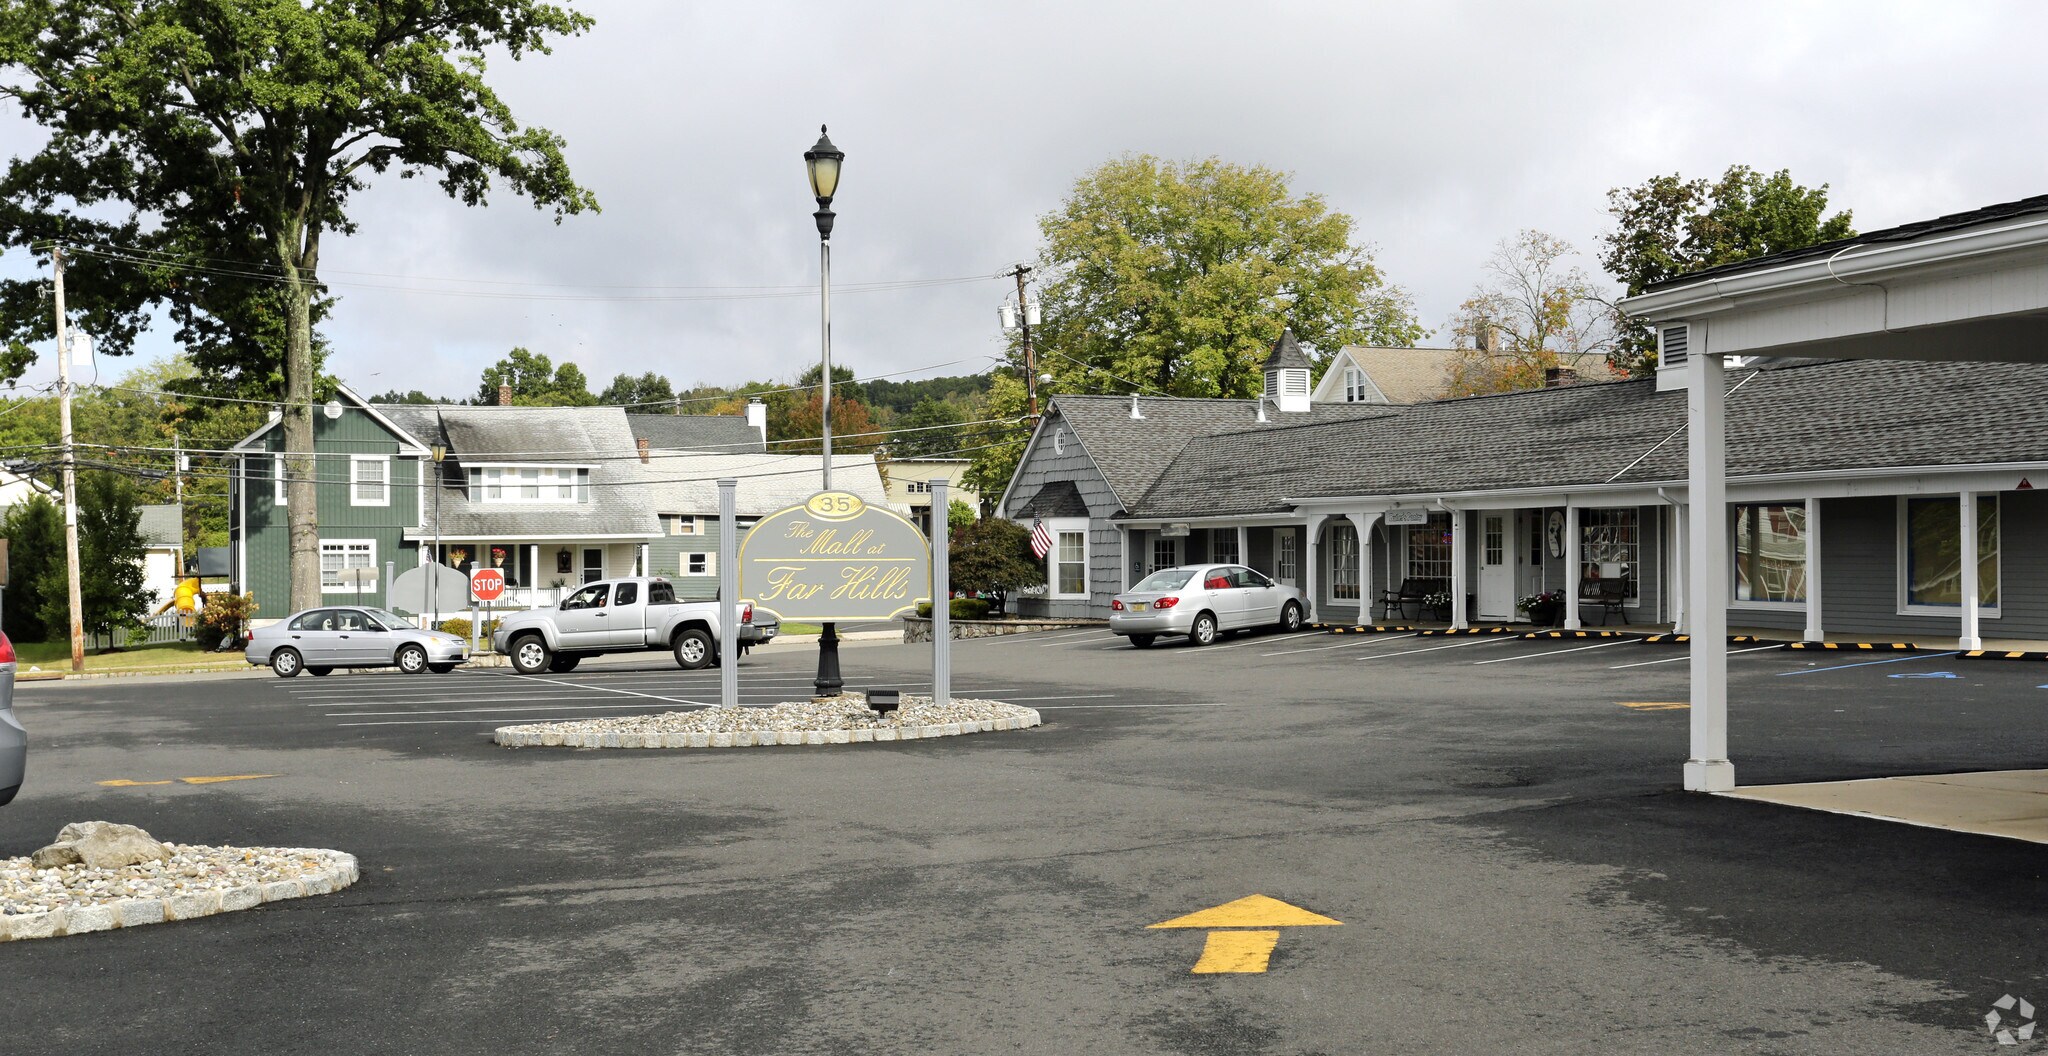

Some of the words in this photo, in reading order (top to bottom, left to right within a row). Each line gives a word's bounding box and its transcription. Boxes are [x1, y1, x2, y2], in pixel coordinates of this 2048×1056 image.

[820, 496, 851, 512] 35
[784, 520, 814, 539] The
[799, 528, 874, 555] Mall
[867, 542, 886, 555] at
[473, 578, 503, 592] STOP
[758, 566, 825, 601] Far
[829, 565, 912, 600] Hills
